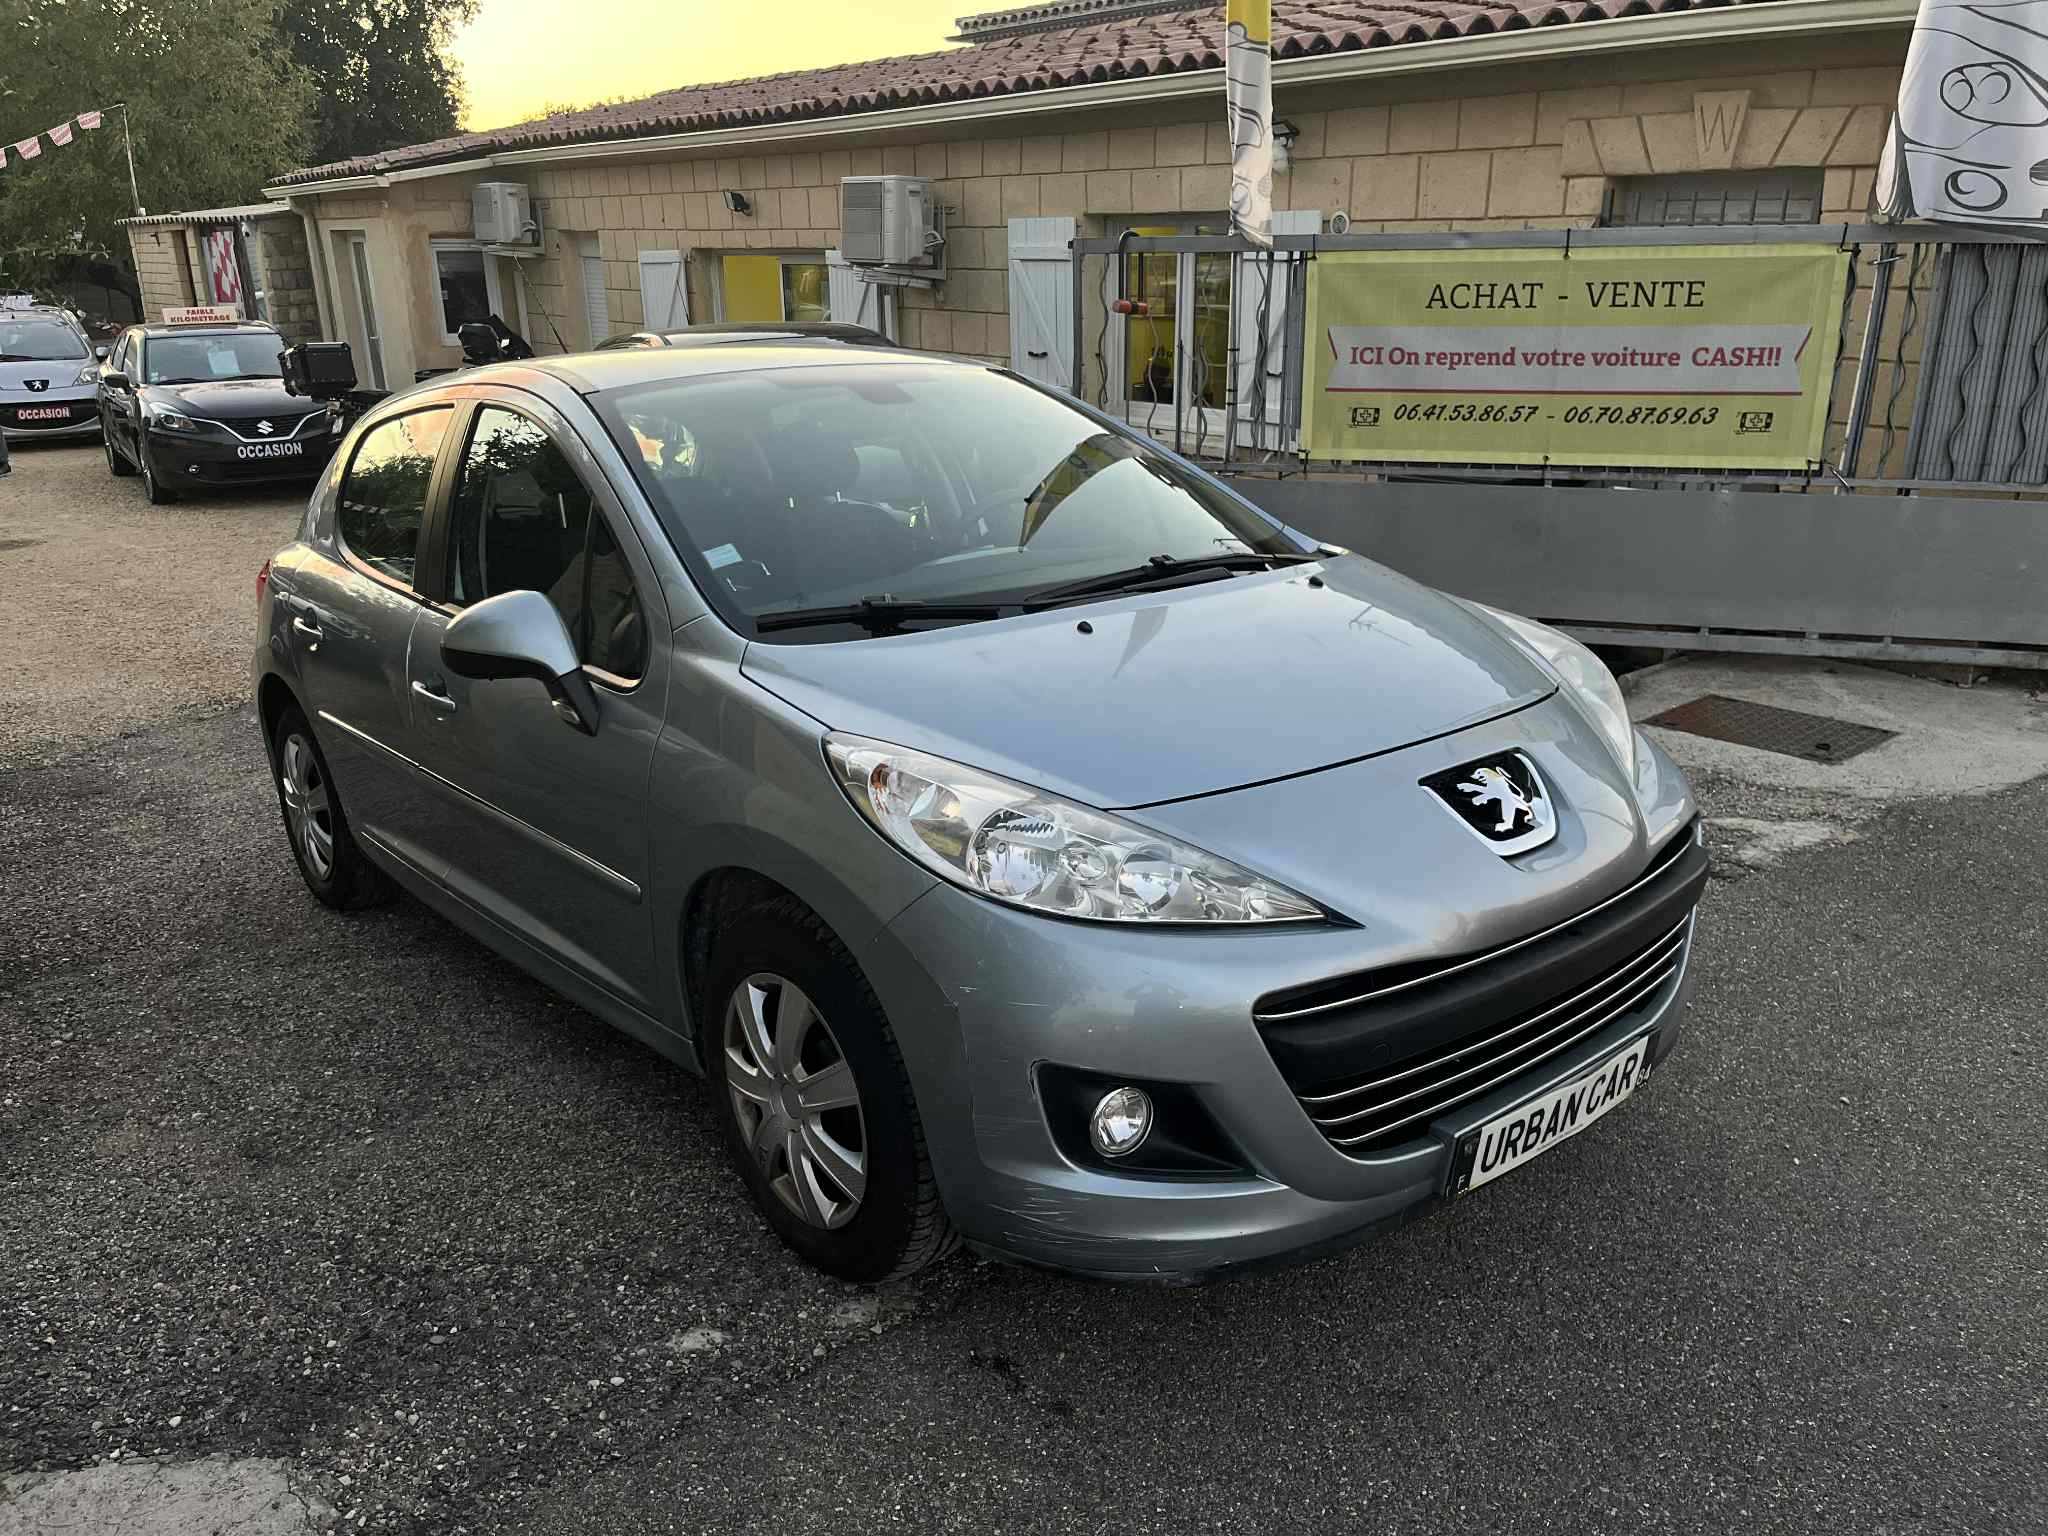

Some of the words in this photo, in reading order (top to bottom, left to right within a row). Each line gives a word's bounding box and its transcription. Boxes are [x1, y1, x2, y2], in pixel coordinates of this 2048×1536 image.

[1699, 103, 1740, 152] W
[1425, 283, 1543, 309] ACHAT
[1585, 280, 1706, 308] VENTE
[170, 315, 231, 323] KILOMETRAGE
[1350, 346, 1384, 365] ICI
[1388, 347, 1419, 365] On
[1424, 346, 1516, 370] reprend
[1521, 348, 1585, 366] votre
[1591, 346, 1680, 366] voiture
[1692, 346, 1782, 367] CASH!!
[18, 407, 70, 420] OCCASION
[1393, 403, 1539, 423] 06.41.53.86.57
[1563, 406, 1719, 425] 06.70.87.69.63
[237, 442, 303, 459] OCCASION
[1480, 1084, 1587, 1173] URBAN
[1585, 1052, 1639, 1116] CAR
